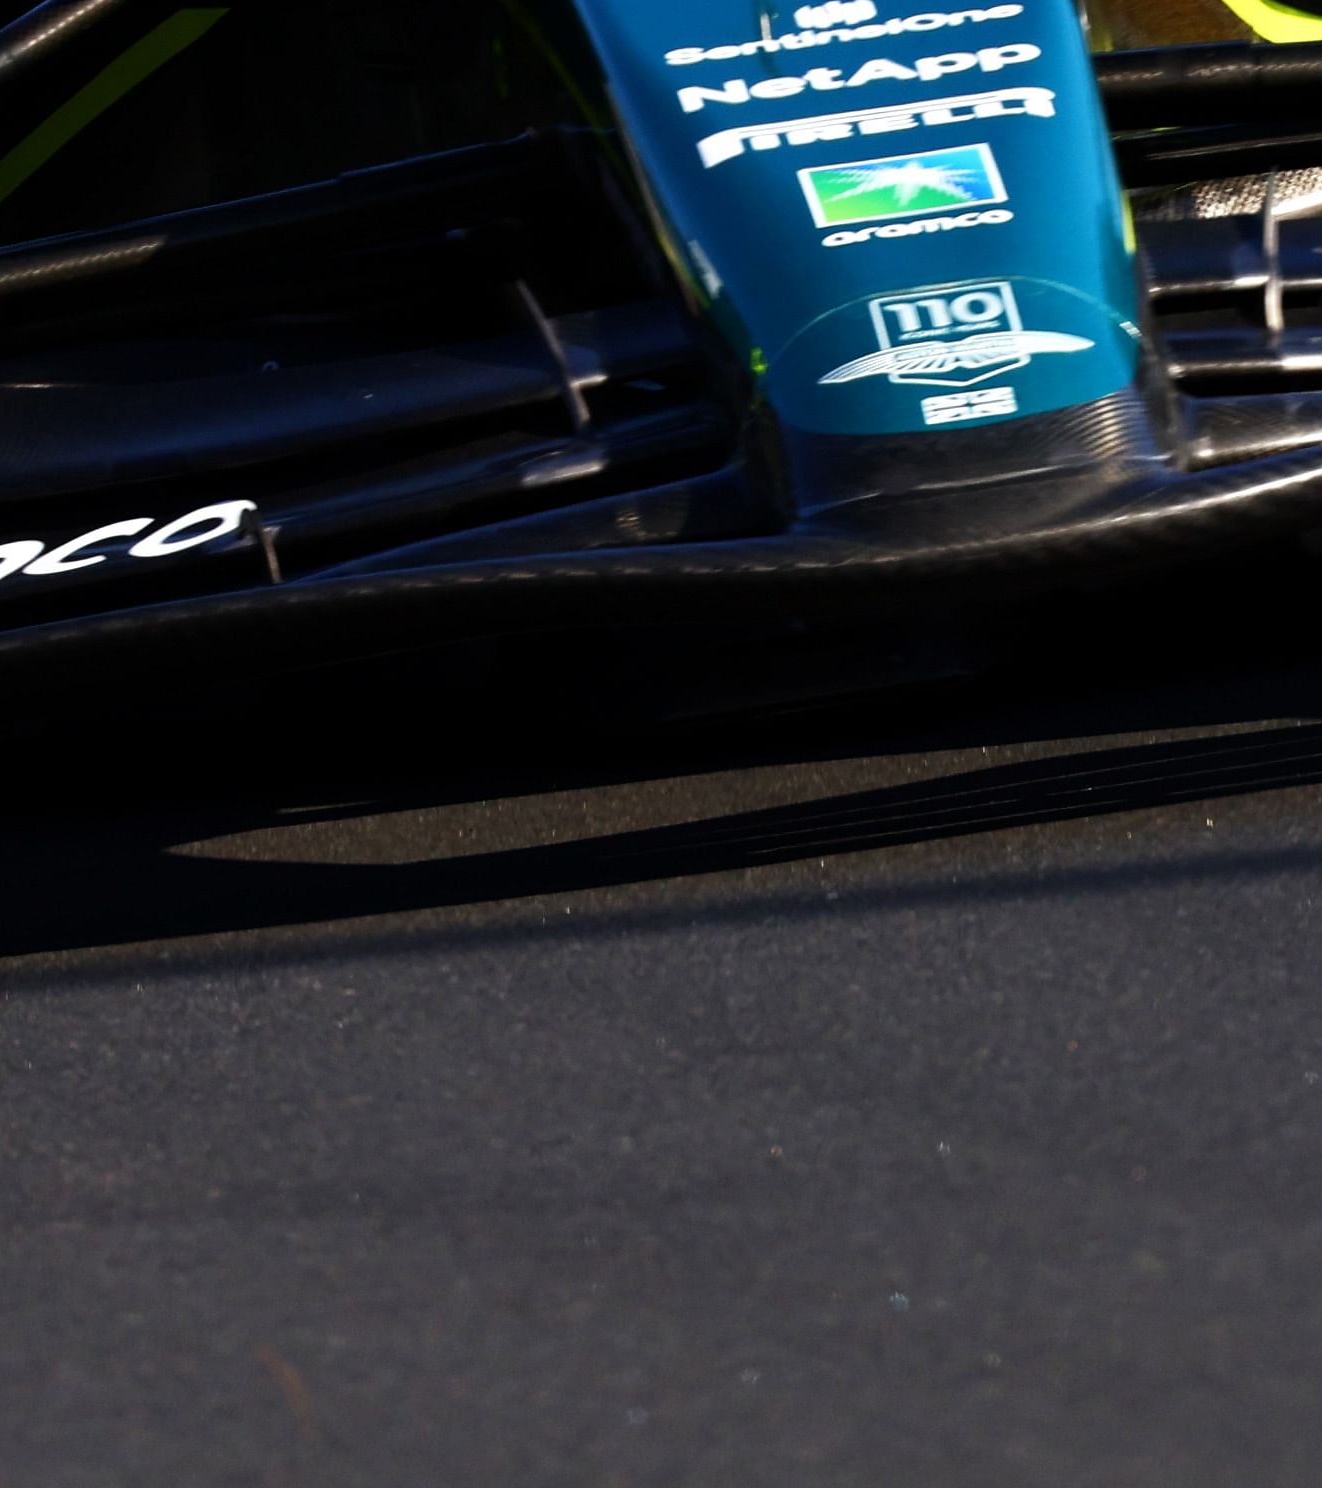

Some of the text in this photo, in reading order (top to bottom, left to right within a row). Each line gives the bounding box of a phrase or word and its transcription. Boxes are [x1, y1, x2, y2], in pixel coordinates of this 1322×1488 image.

[664, 3, 1025, 66] SentinelOne
[677, 42, 1042, 114] NetApp
[696, 86, 1056, 170] PIRELLI
[821, 208, 1015, 248] aramco
[882, 291, 1006, 332] 110
